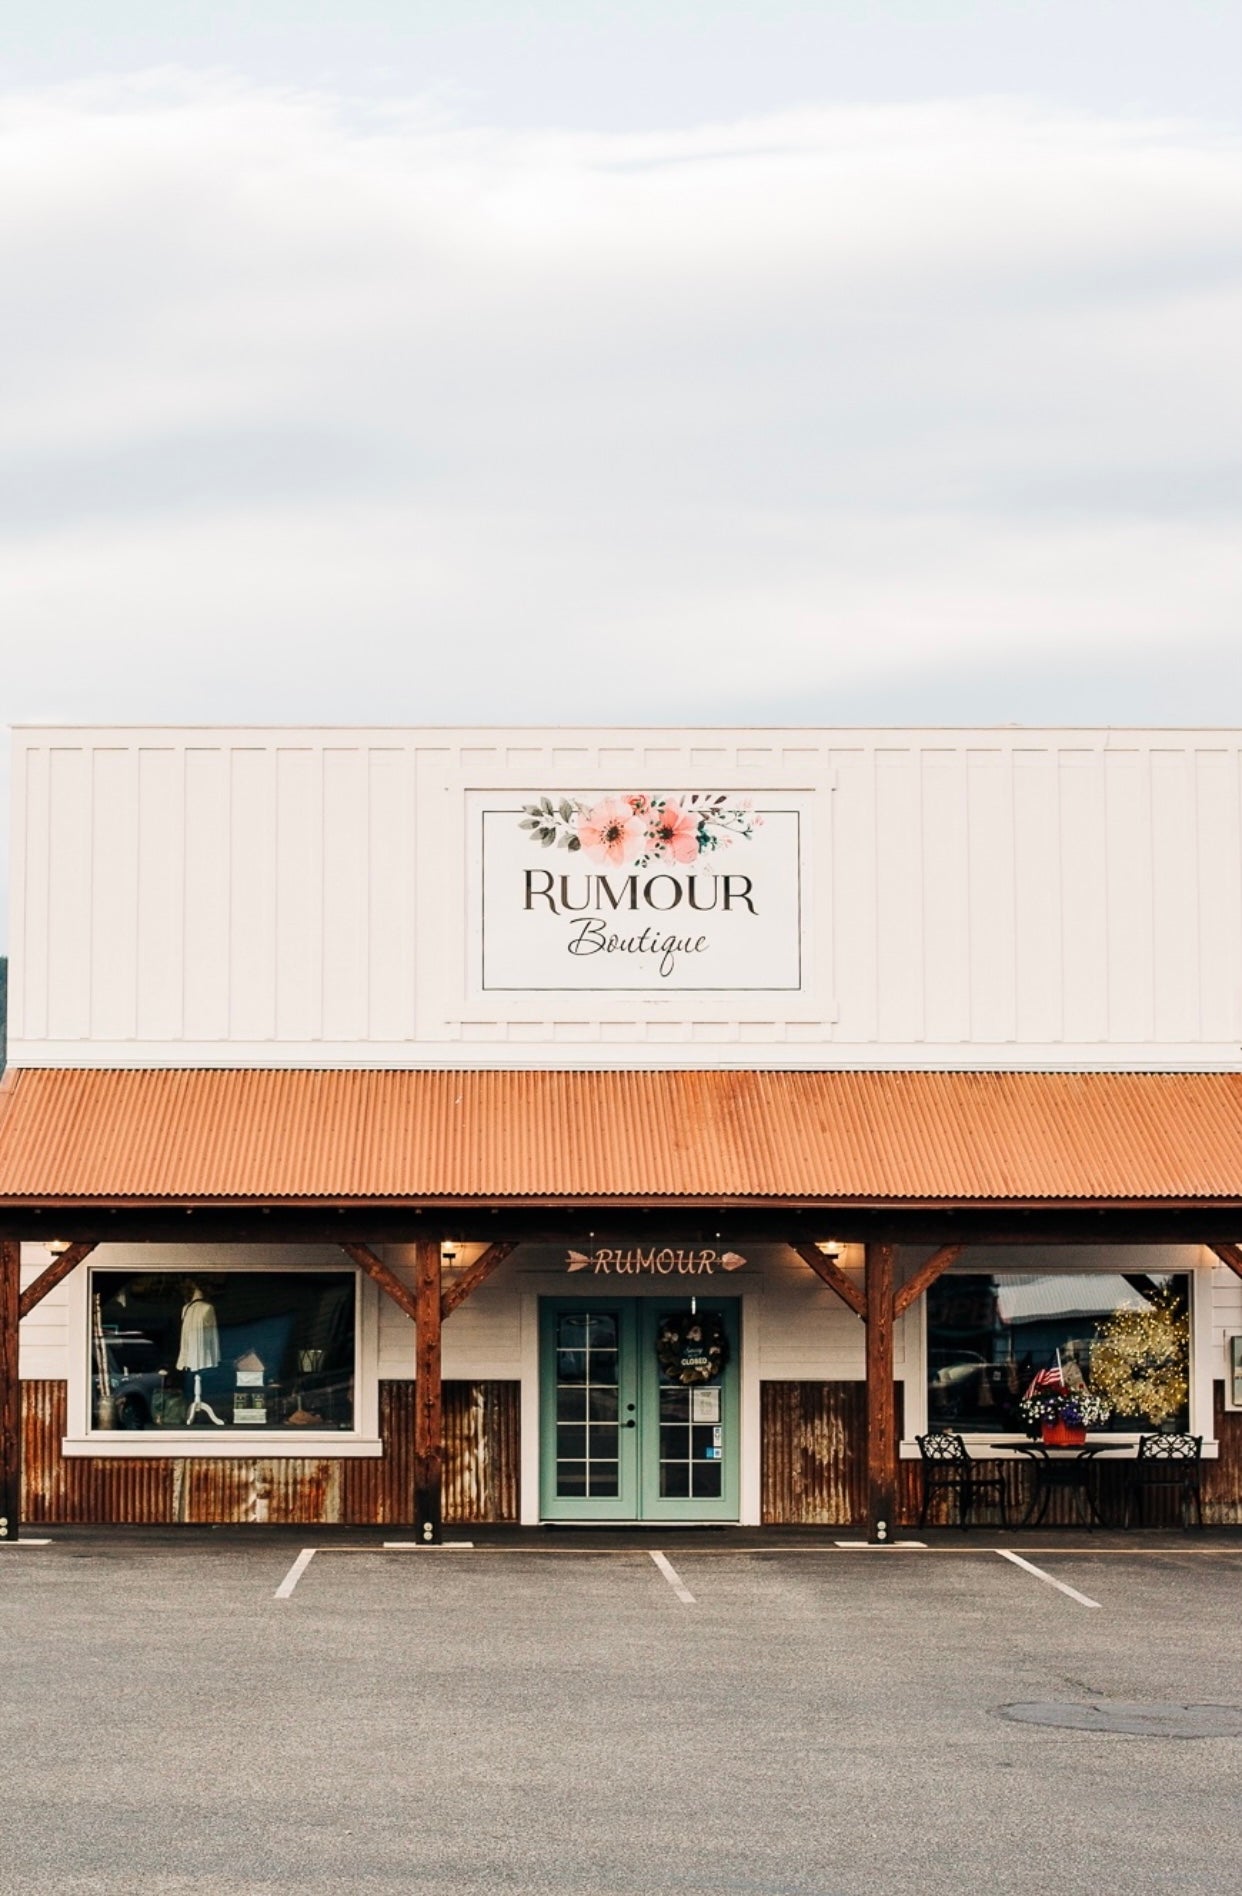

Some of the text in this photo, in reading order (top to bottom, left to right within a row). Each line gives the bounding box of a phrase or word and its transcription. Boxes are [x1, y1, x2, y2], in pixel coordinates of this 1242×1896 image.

[523, 869, 759, 915] RUMOUR
[567, 917, 710, 977] Boutique
[594, 1247, 716, 1274] RUMOUR
[681, 1357, 708, 1366] CLOSED
